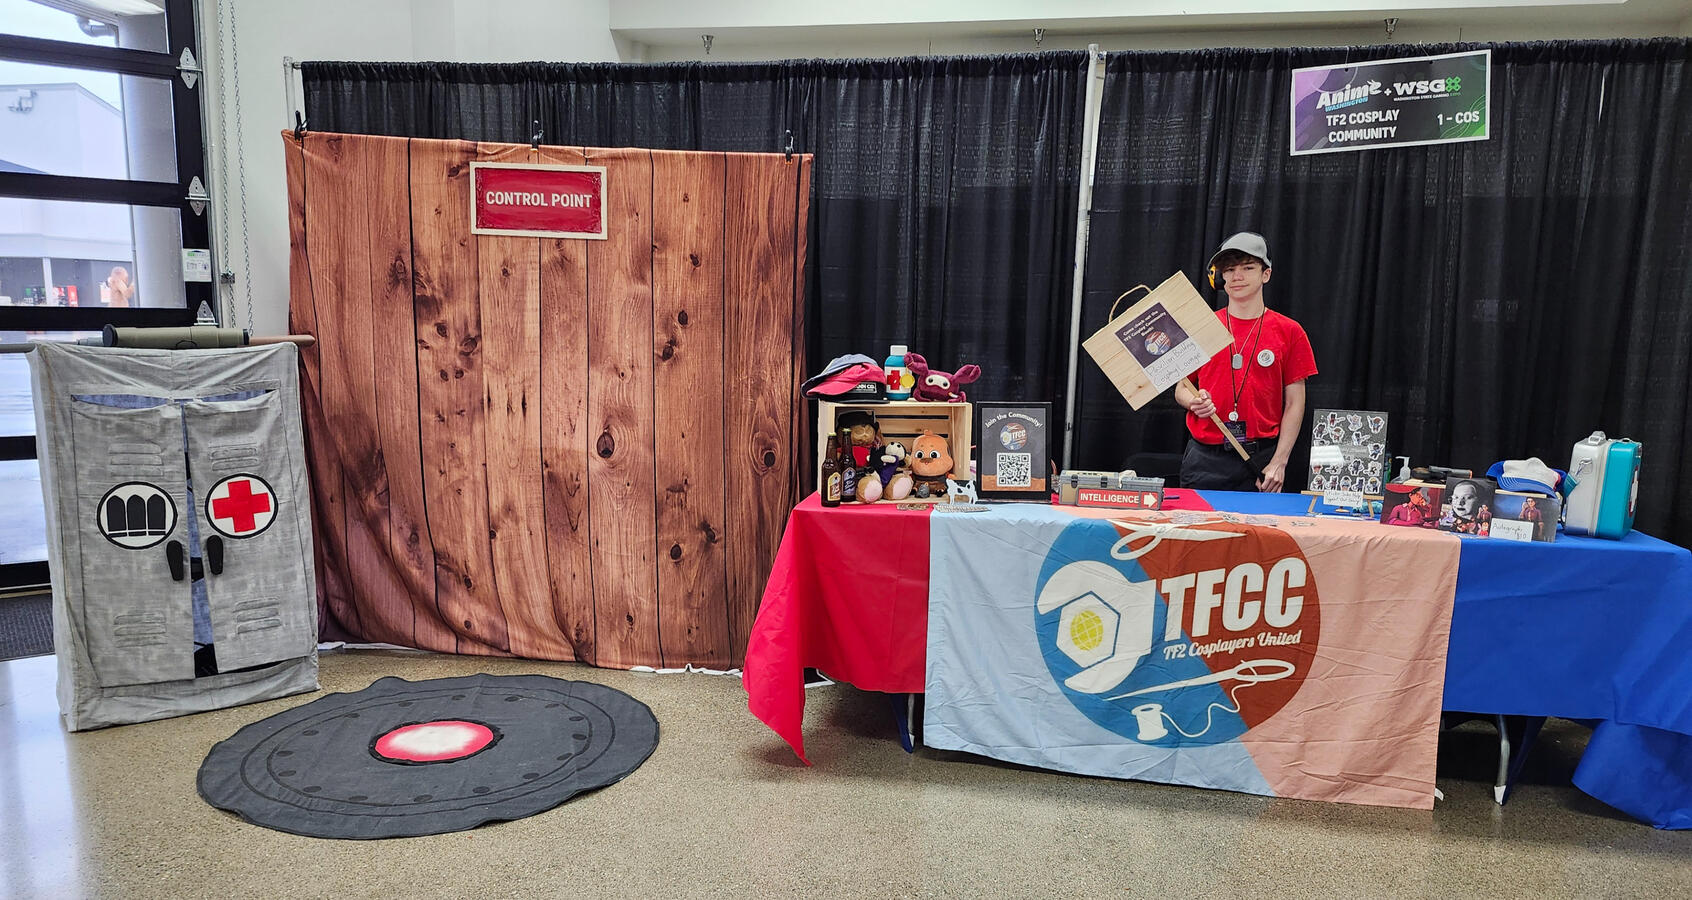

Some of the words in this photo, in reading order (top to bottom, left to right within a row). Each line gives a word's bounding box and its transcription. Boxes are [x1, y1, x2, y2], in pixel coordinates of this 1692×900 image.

[1316, 80, 1382, 109] Anime
[1325, 96, 1369, 112] WASHINGTON
[1326, 114, 1347, 126] TF2
[1348, 109, 1400, 125] COSPLAY
[1437, 113, 1443, 126] 1
[1455, 110, 1480, 124] COS
[1328, 126, 1398, 143] COMMUNITY
[486, 191, 549, 207] CONTROL
[551, 193, 593, 208] POINT
[985, 418, 997, 428] Join
[996, 413, 1007, 421] the
[1008, 411, 1043, 428] Community!
[1012, 430, 1026, 439] TFCC
[1080, 493, 1139, 504] INTELLIGENCE
[1161, 557, 1307, 641] TFCC
[1163, 644, 1186, 660] TF2
[1188, 636, 1255, 658] Cosplayers
[1257, 630, 1302, 647] United
